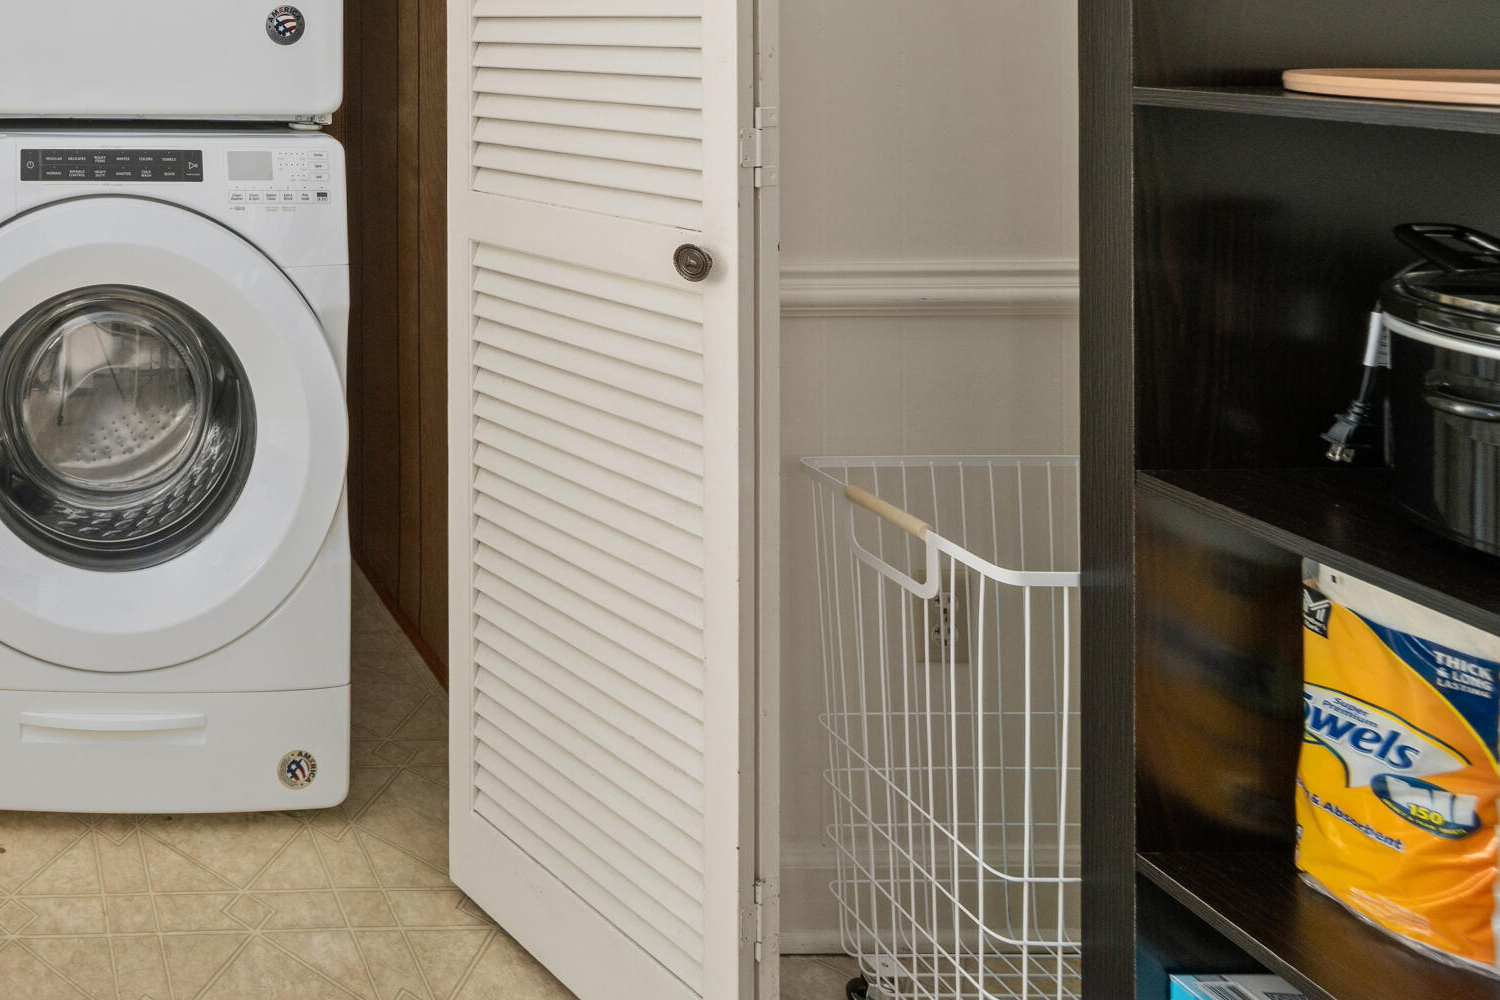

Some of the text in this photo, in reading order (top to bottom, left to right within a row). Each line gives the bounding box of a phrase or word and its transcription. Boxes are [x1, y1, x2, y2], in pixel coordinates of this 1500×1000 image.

[267, 6, 302, 24] AMERICA
[1432, 650, 1494, 682] THICK
[1435, 666, 1494, 692] & LONG
[1435, 677, 1492, 699] LASTING
[1322, 699, 1379, 728] Premium
[1333, 697, 1370, 716] Super
[1303, 692, 1420, 769] wels
[296, 750, 318, 783] AMERICA
[1322, 801, 1406, 853] Absorbent
[1406, 802, 1445, 828] 150
